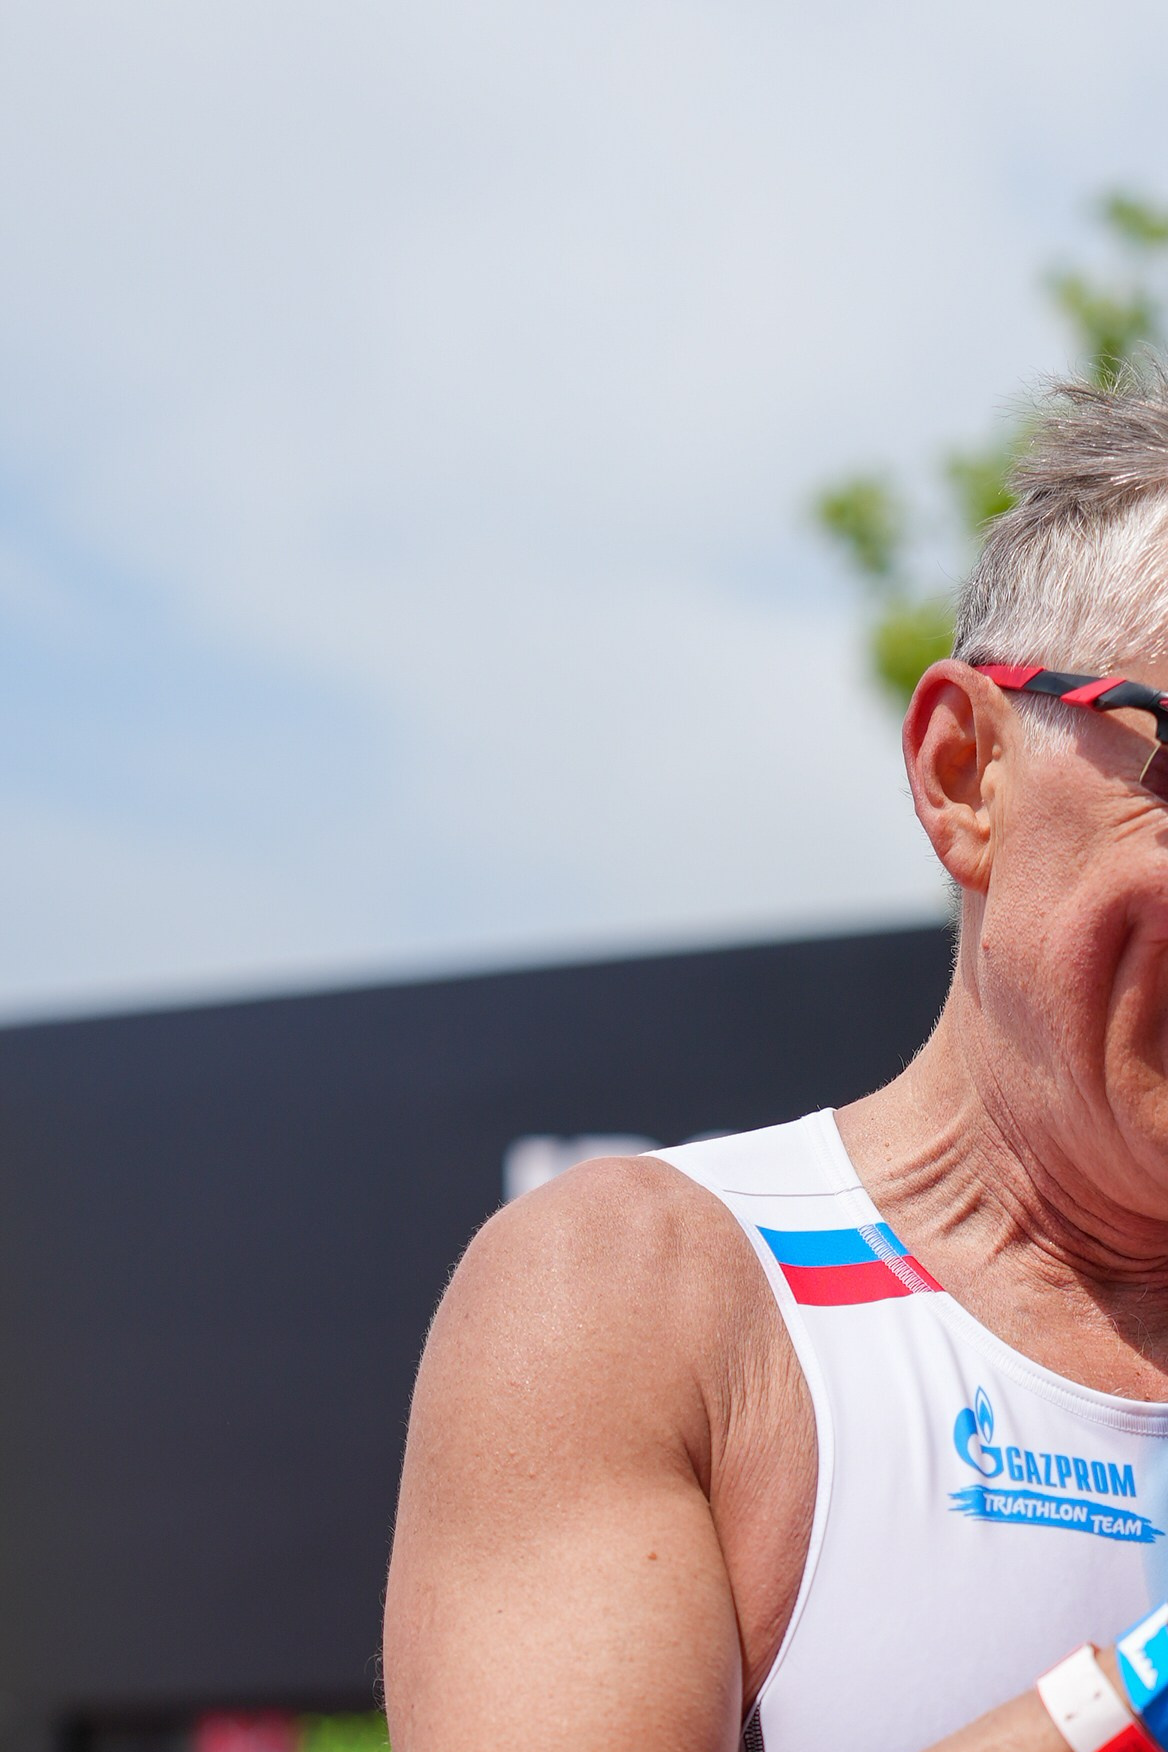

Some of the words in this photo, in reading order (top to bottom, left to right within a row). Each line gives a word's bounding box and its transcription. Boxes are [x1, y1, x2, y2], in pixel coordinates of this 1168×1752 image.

[1005, 1446, 1137, 1498] GAZPROM
[983, 1494, 1088, 1522] TRIATHLON
[1090, 1515, 1143, 1537] TEAM
